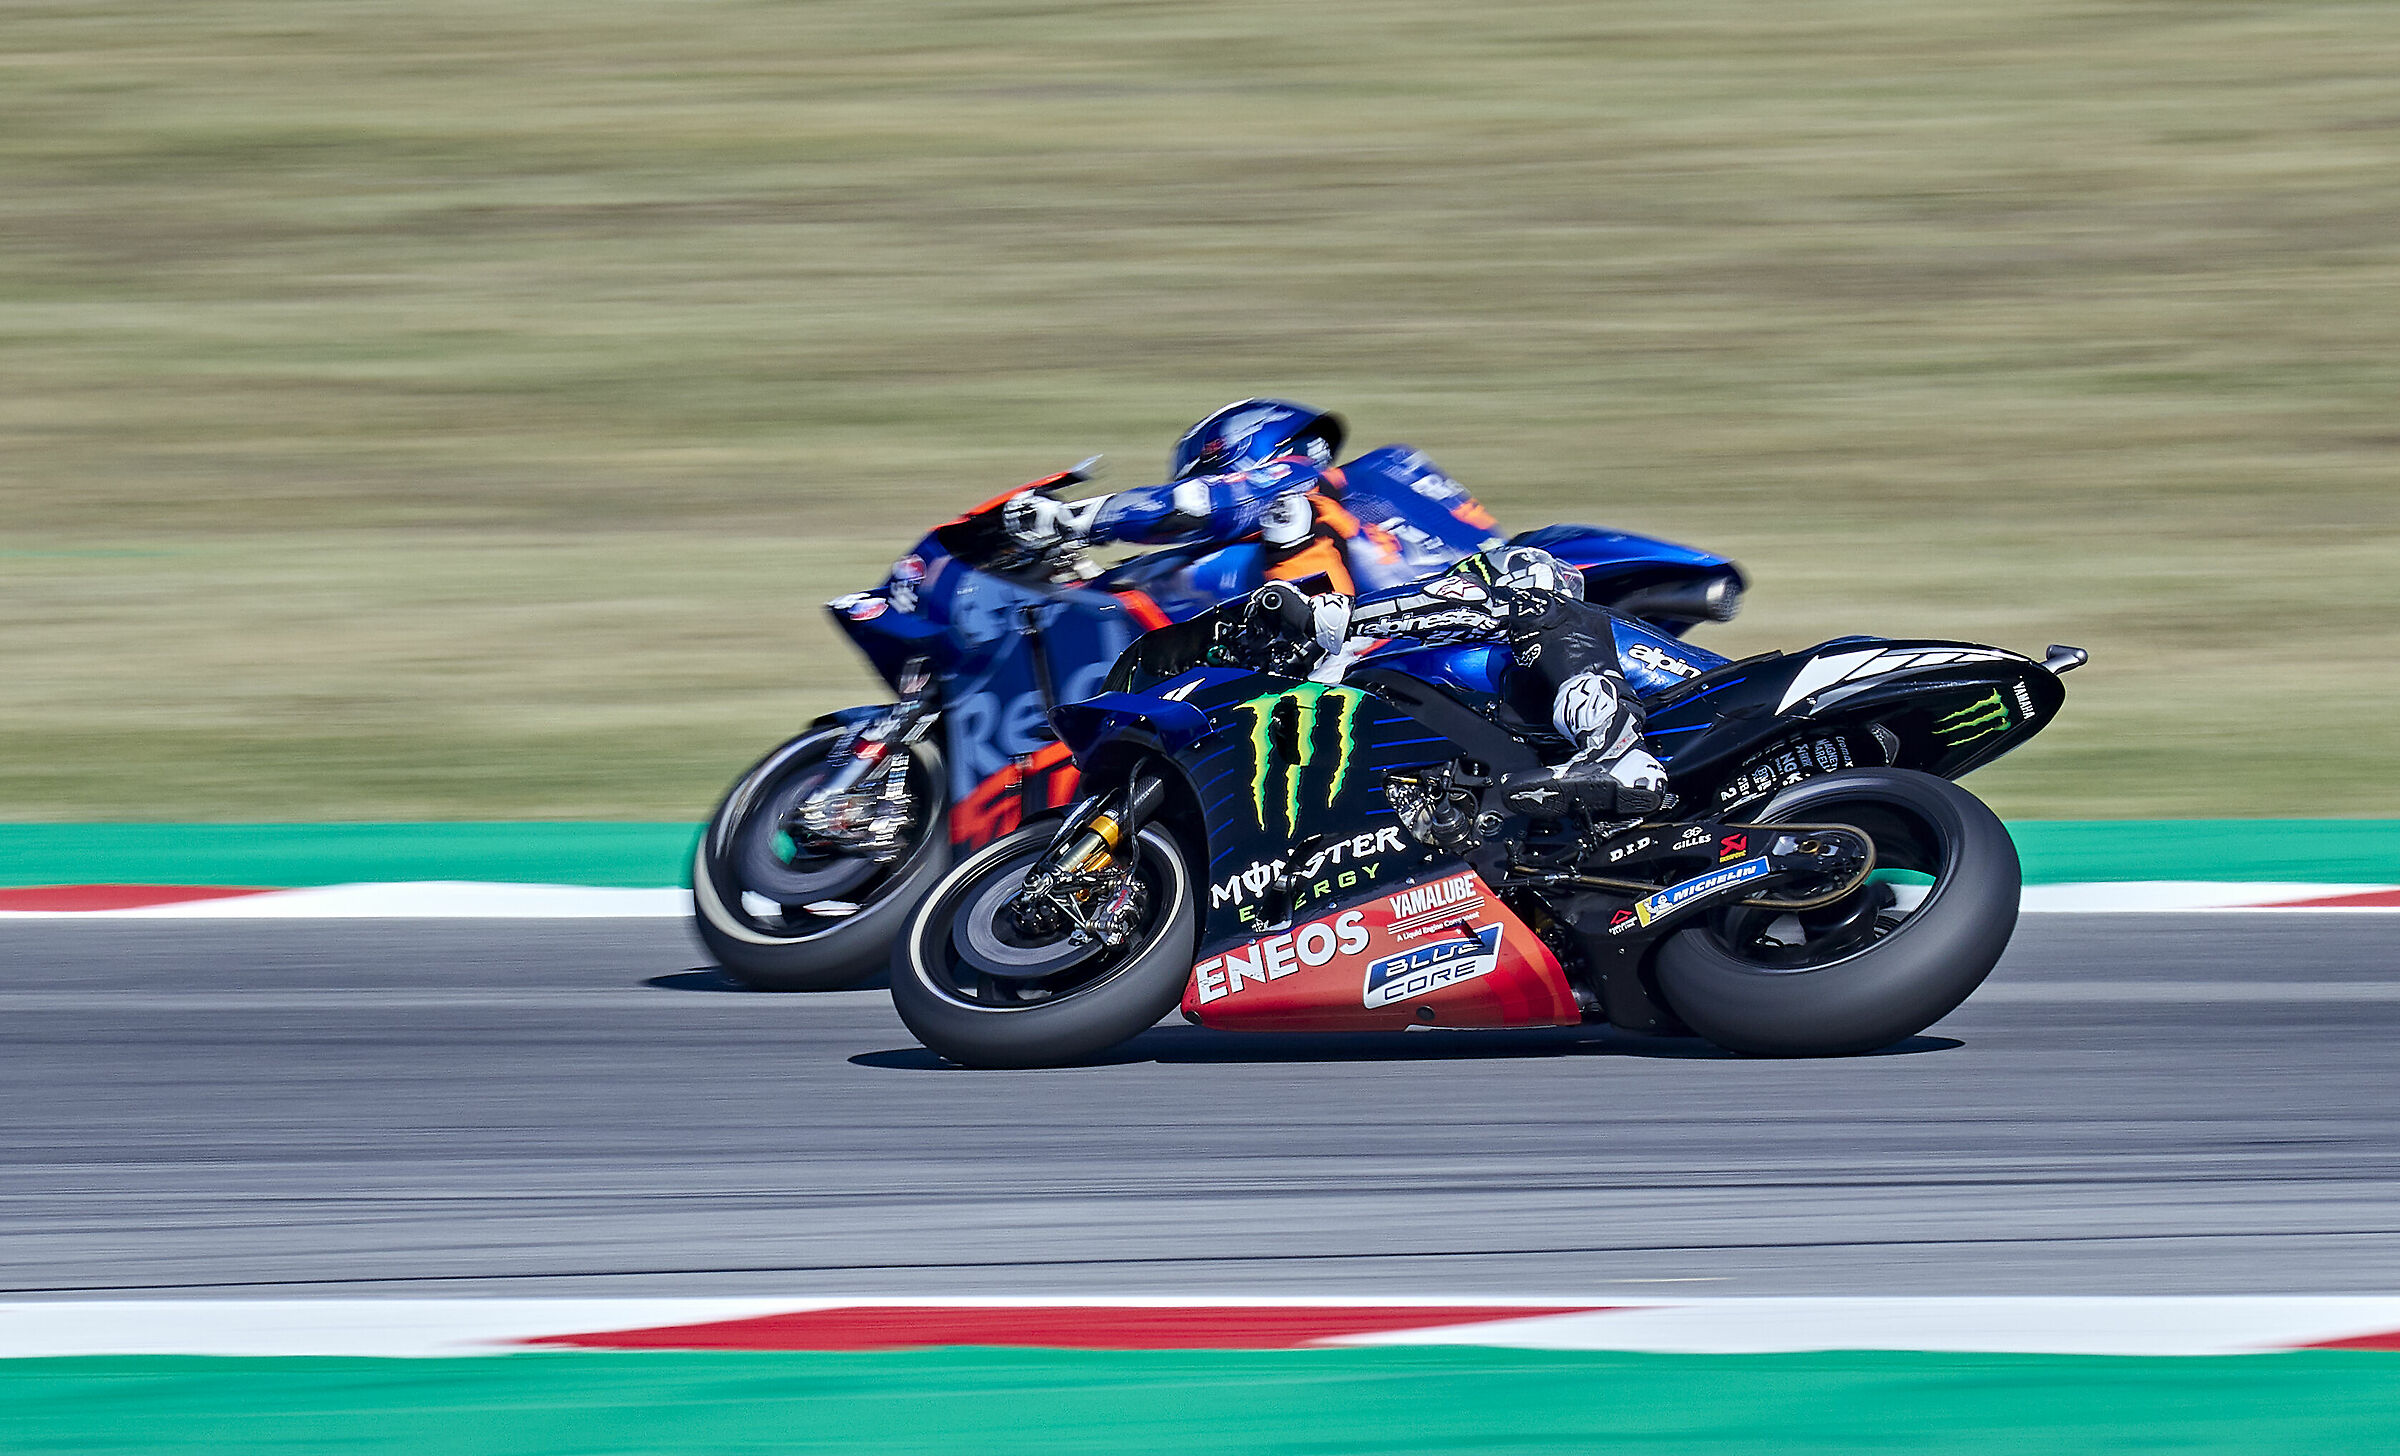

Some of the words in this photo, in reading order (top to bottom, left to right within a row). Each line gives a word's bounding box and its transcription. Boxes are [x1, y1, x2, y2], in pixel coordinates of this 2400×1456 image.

[1361, 606, 1499, 635] alpinestars
[2013, 681, 2035, 720] YAMAHA
[1610, 837, 1650, 862] D.I.D
[1673, 834, 1712, 850] GILLES
[1239, 863, 1379, 922] EERGY
[1389, 875, 1477, 919] YAMALUBE
[1673, 866, 1756, 902] MICHELIN
[1403, 927, 1422, 940] Liquid
[1423, 921, 1443, 935] Engine
[1196, 910, 1370, 1004] ENEOS
[1386, 941, 1480, 977] BLUE
[1385, 960, 1476, 1000] CORE
